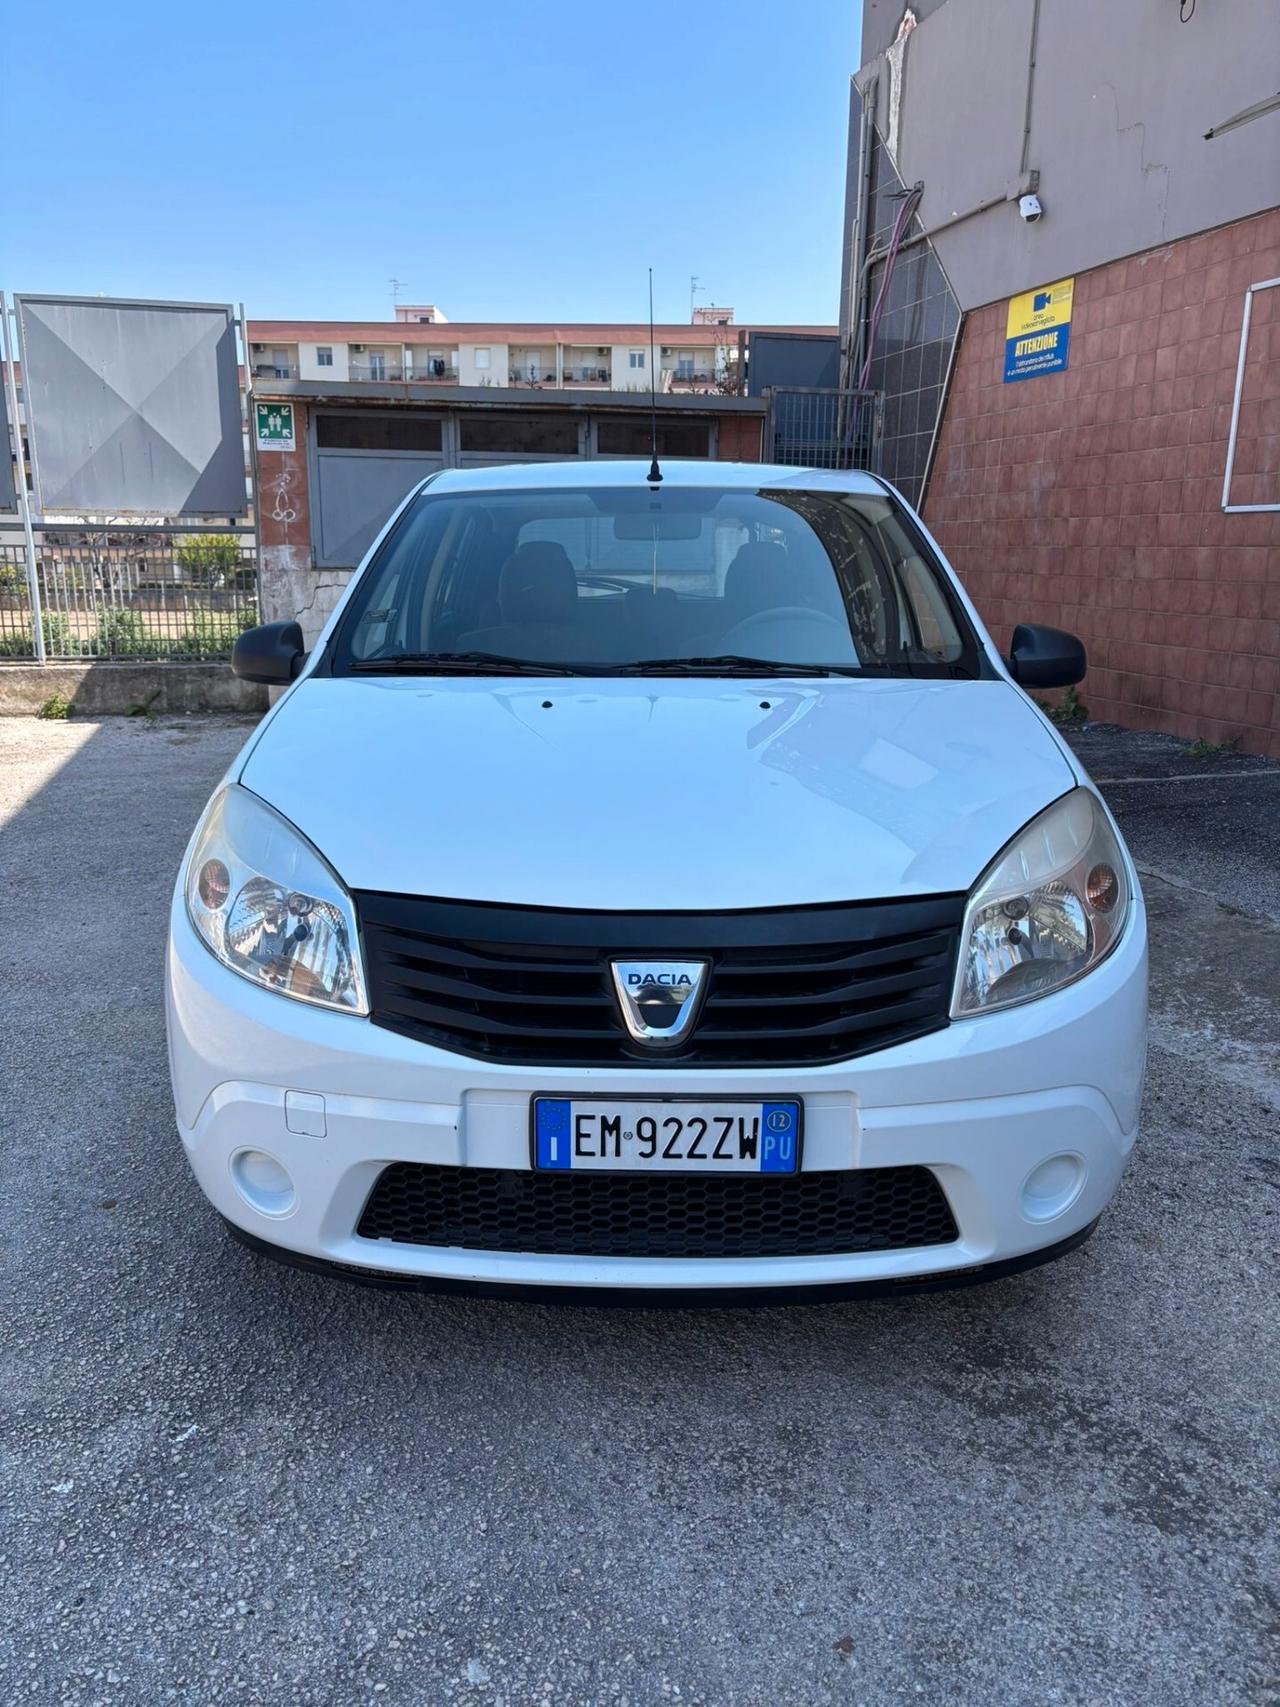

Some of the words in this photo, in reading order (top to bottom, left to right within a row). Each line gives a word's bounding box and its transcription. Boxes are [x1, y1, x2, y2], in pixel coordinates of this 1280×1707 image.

[1015, 331, 1058, 357] ATTENZIONE
[628, 973, 692, 985] DACIA
[772, 1114, 786, 1128] 12
[575, 1114, 621, 1158] EM
[636, 1116, 760, 1160] 922ZW
[764, 1135, 792, 1161] PU
